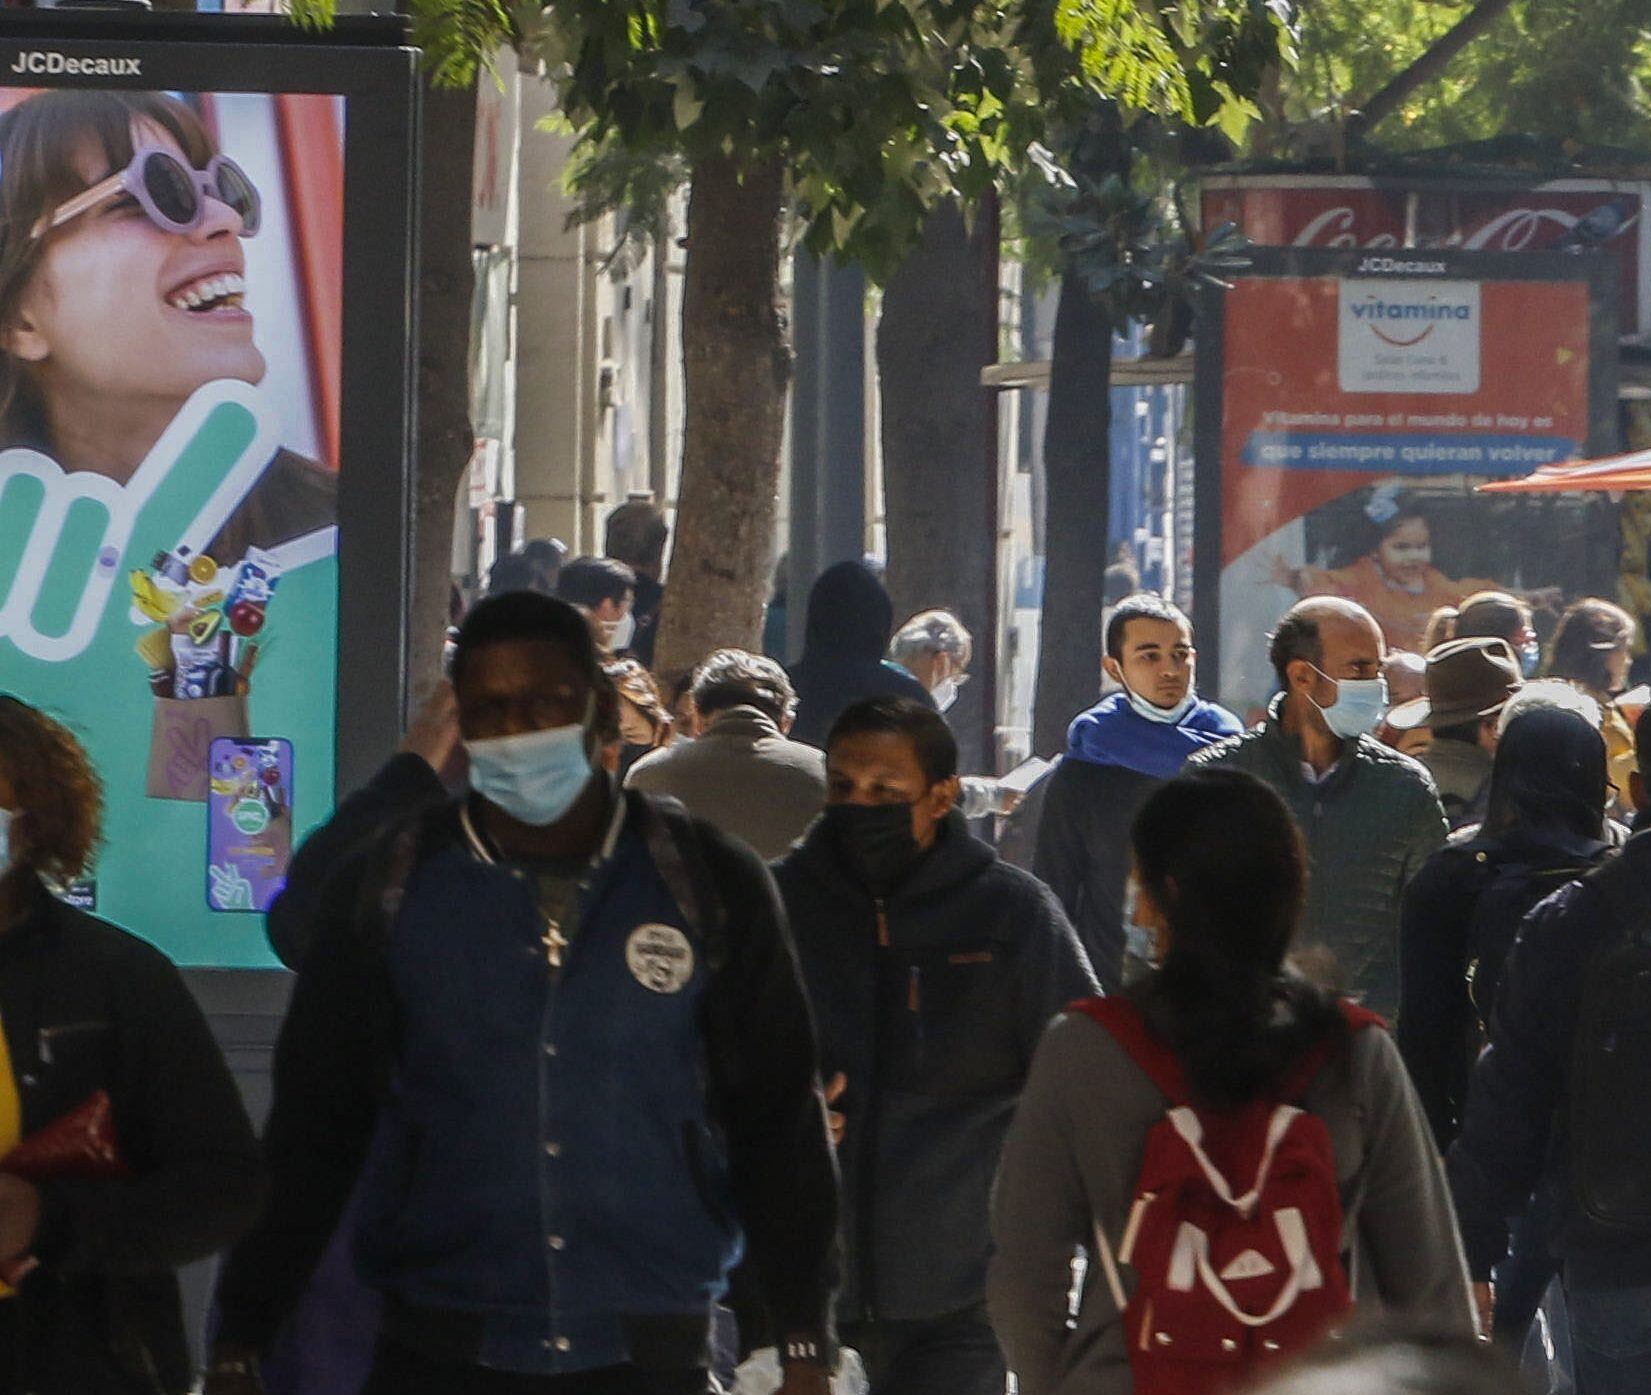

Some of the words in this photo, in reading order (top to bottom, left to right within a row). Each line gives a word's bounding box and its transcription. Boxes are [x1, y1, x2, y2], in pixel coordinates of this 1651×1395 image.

[11, 51, 142, 75] JCDecaux
[1358, 257, 1447, 273] JCDecaux
[1351, 296, 1470, 319] vitamina
[1307, 441, 1395, 463] siempre
[1401, 442, 1483, 463] quieran
[1488, 444, 1556, 461] volver
